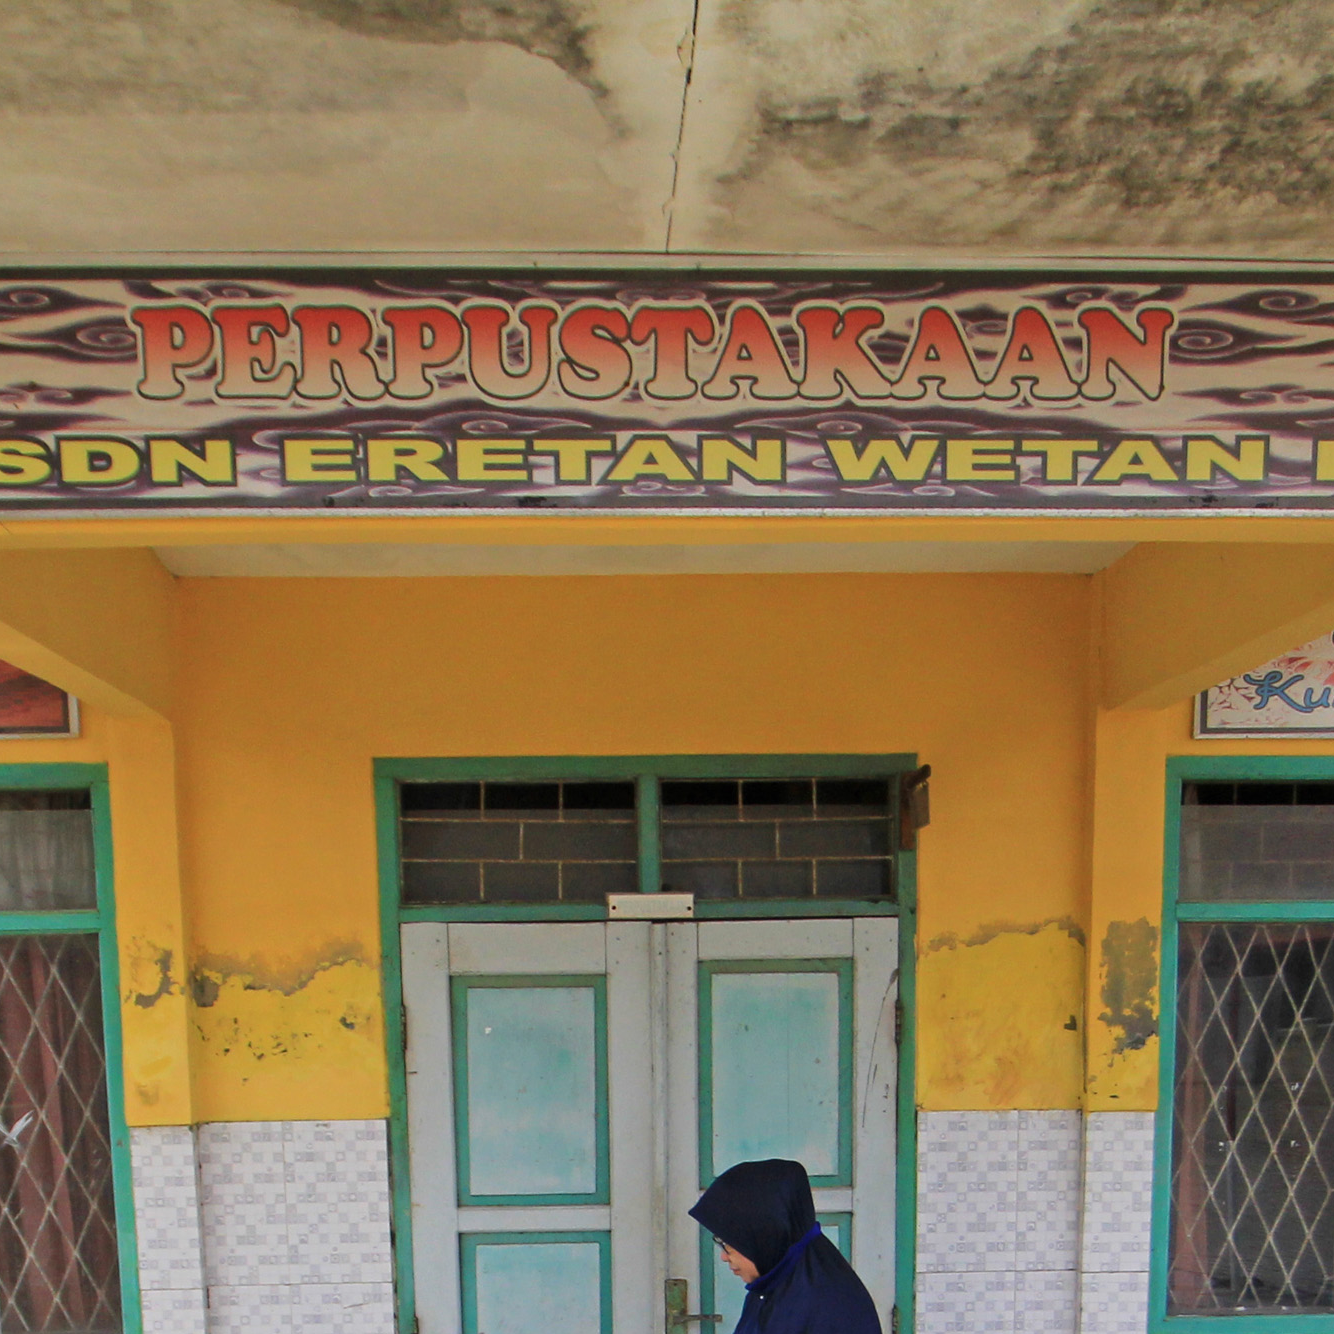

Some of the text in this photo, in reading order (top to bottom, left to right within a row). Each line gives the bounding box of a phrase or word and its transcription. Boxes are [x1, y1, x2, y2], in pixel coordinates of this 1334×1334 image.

[129, 302, 1174, 401] PERPUSTAKAAN
[280, 435, 786, 486] ERETAN
[824, 435, 1271, 485] WETAN
